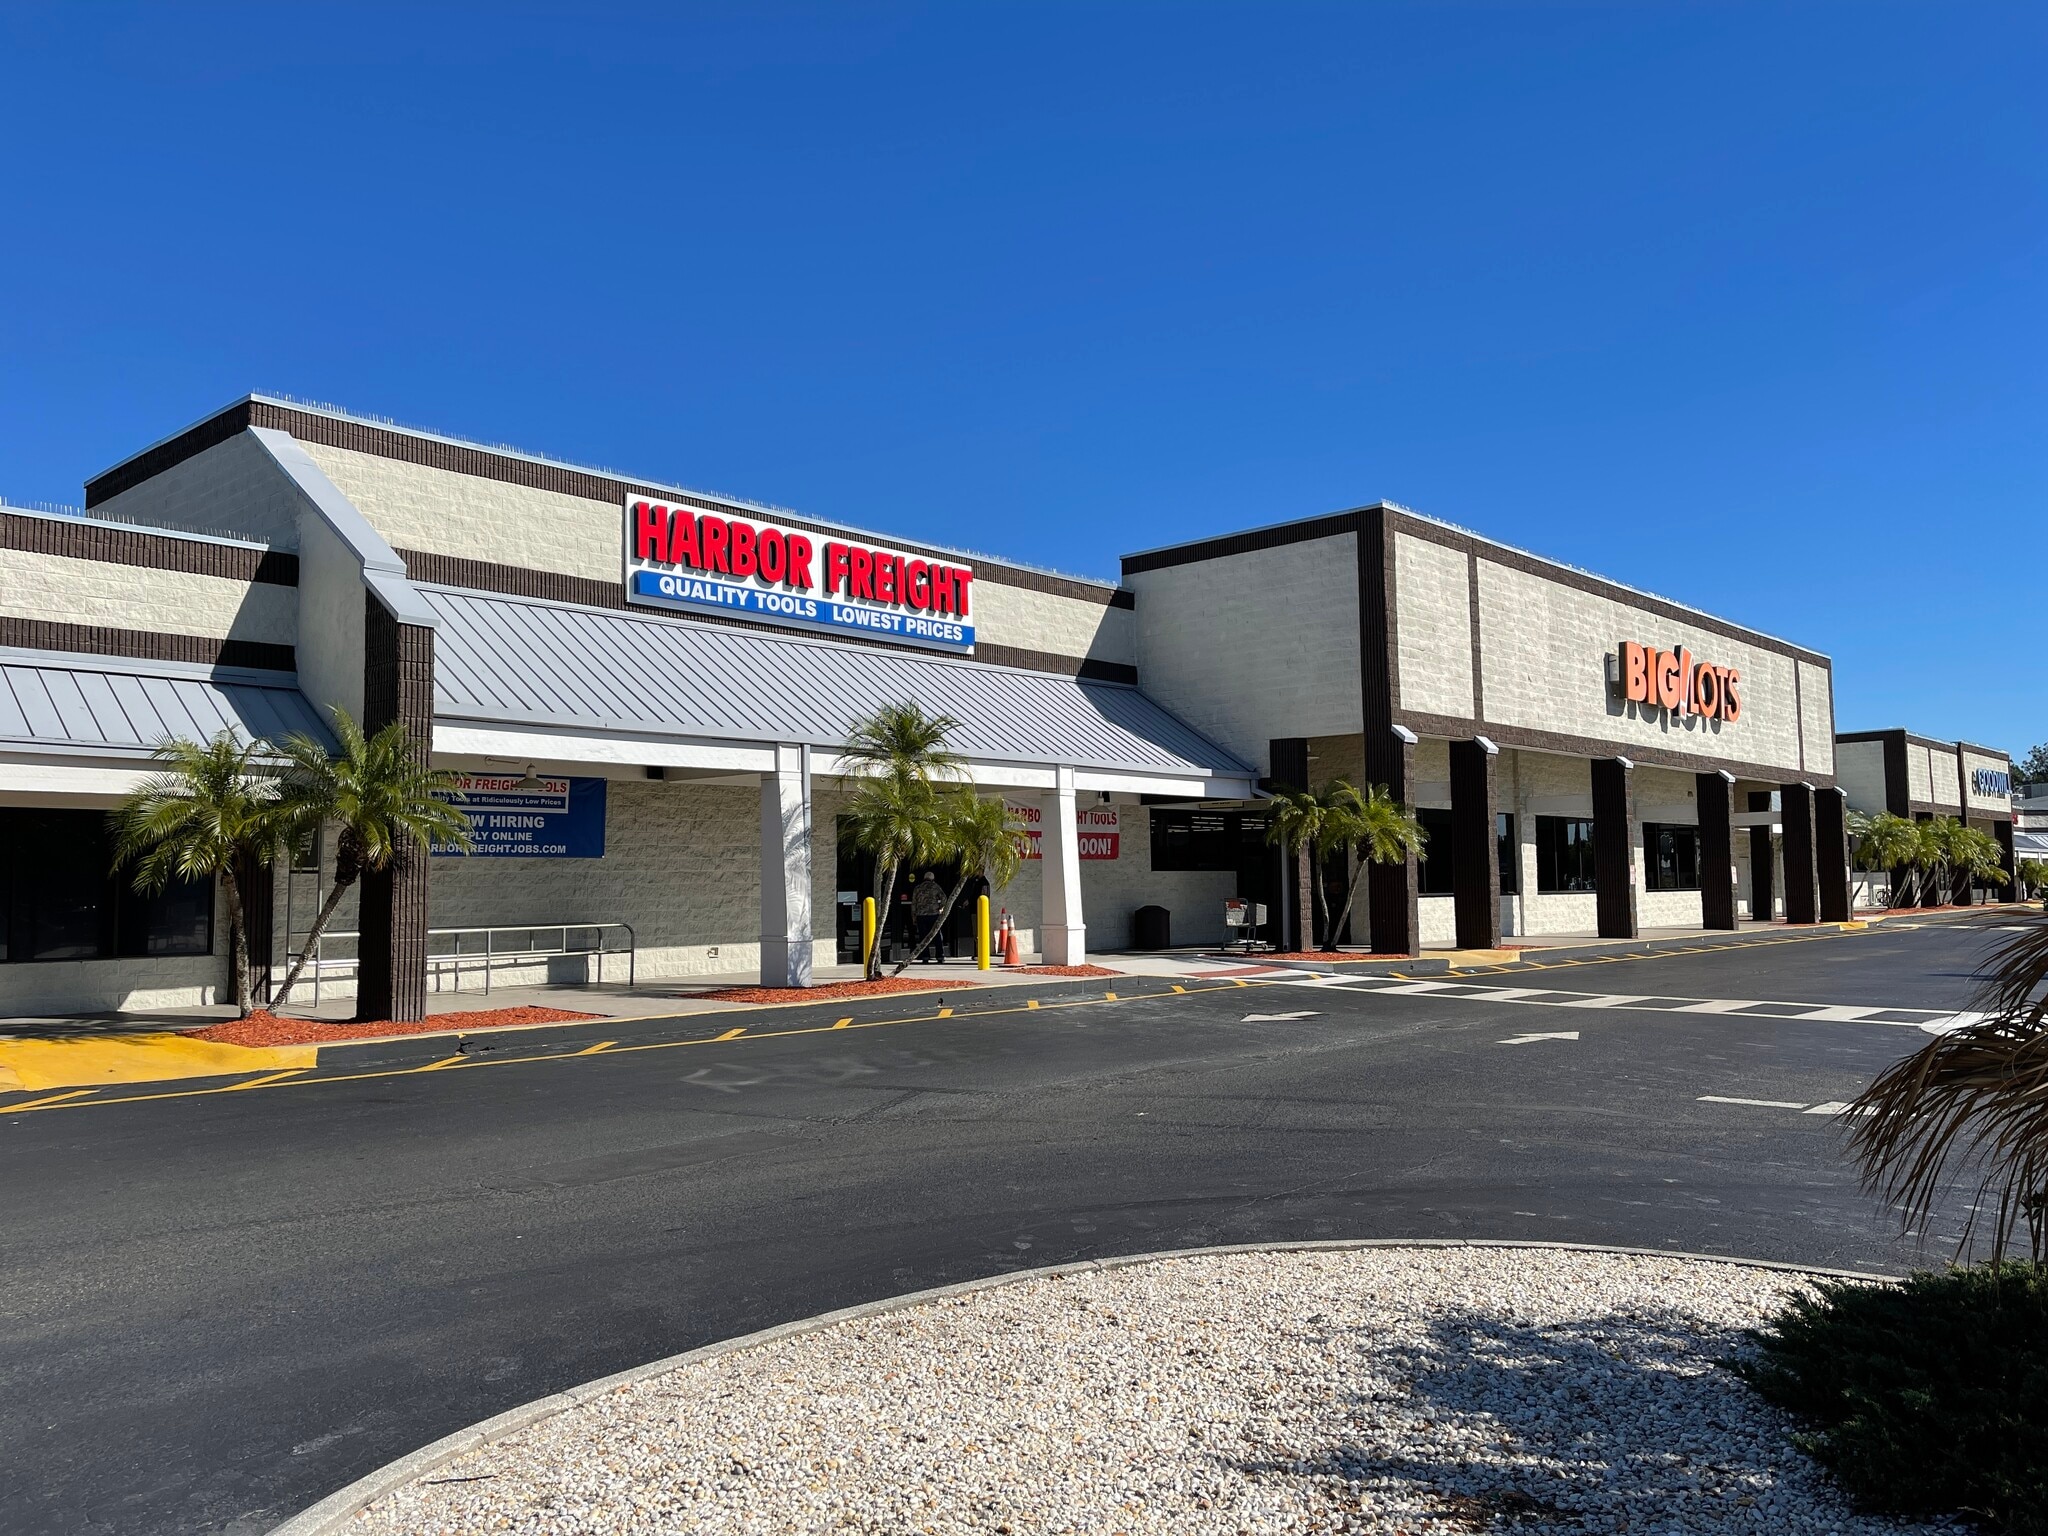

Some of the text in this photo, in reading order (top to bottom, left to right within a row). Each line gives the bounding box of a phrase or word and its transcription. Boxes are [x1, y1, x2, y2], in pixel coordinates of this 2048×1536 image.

[635, 501, 974, 617] HARBOR FREIGHT
[659, 576, 963, 641] QUALITY TOOLS LOWEST PRICES
[475, 779, 524, 791] FREIG
[481, 797, 524, 805] Ridiculously
[540, 798, 562, 806] Prices
[489, 815, 545, 829] HIRING
[1089, 812, 1117, 825] TOOLS
[460, 831, 533, 841] PPLY ONLINE
[1079, 837, 1112, 855] OON!
